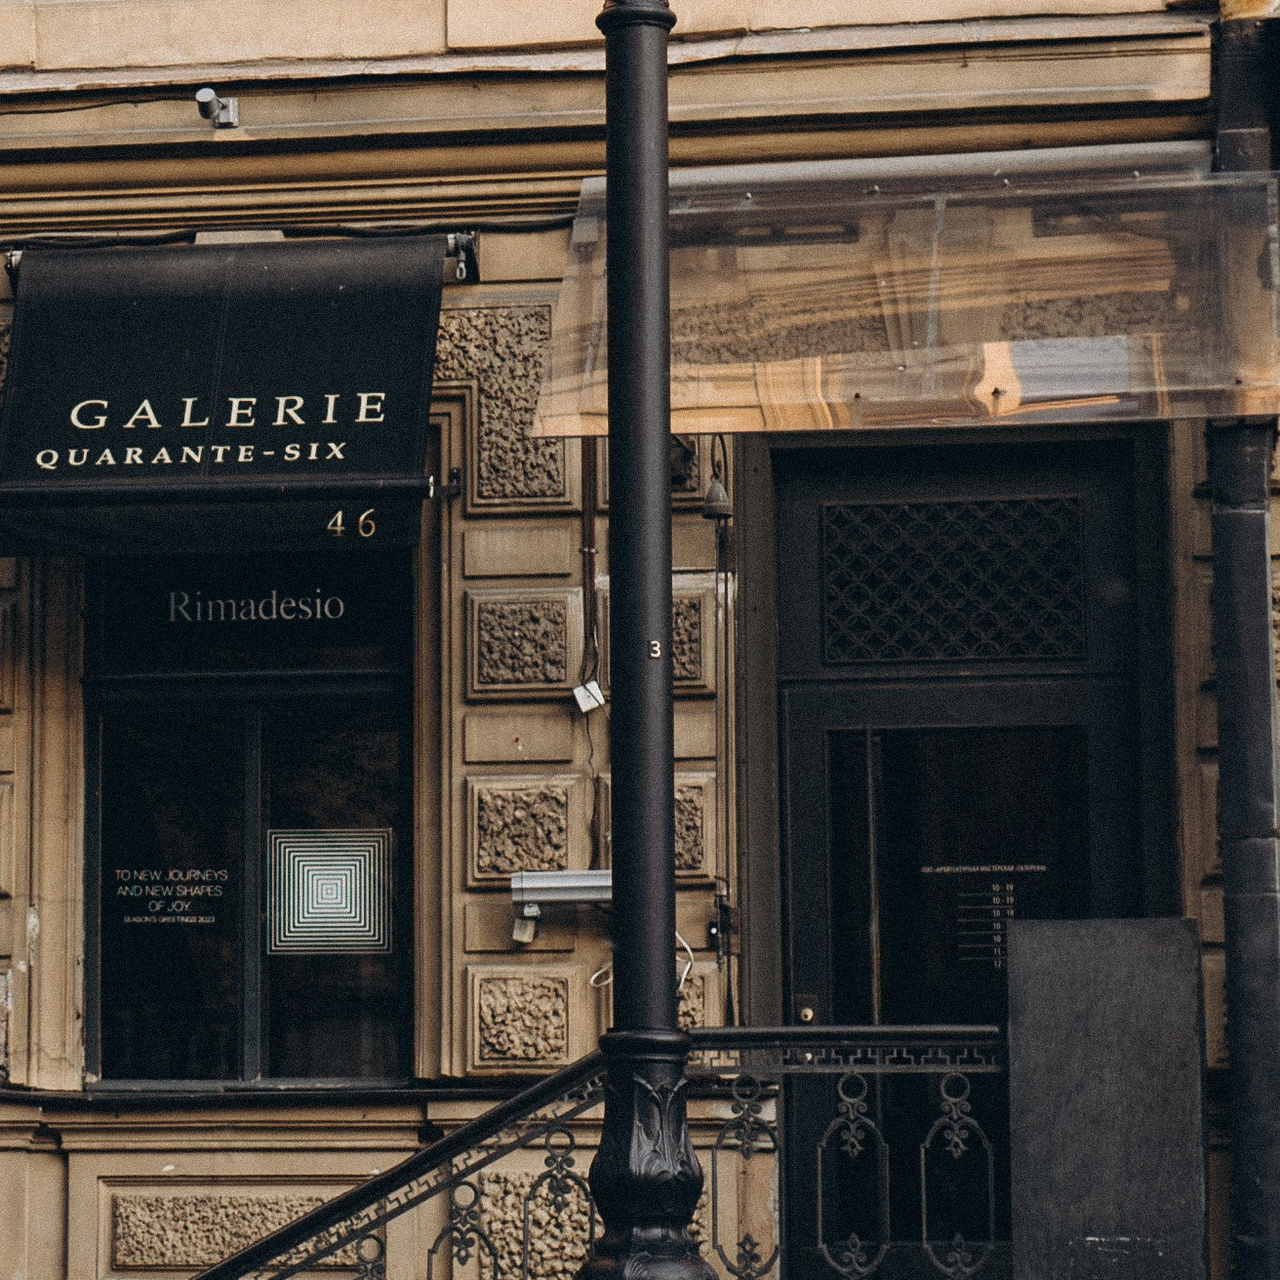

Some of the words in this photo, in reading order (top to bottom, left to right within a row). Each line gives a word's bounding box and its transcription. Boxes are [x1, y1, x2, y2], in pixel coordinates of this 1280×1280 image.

[70, 392, 386, 430] GALERIE
[35, 442, 346, 470] QUARANTE-SIX
[327, 508, 376, 538] 46
[169, 589, 345, 621] Rimadesio
[650, 640, 661, 658] 3
[115, 869, 131, 881] TO
[133, 869, 162, 881] NEW
[164, 869, 228, 881] JOURNEYS
[116, 885, 143, 896] AND
[145, 885, 174, 896] NEW
[176, 885, 223, 896] SHAPES
[148, 900, 165, 912] OF
